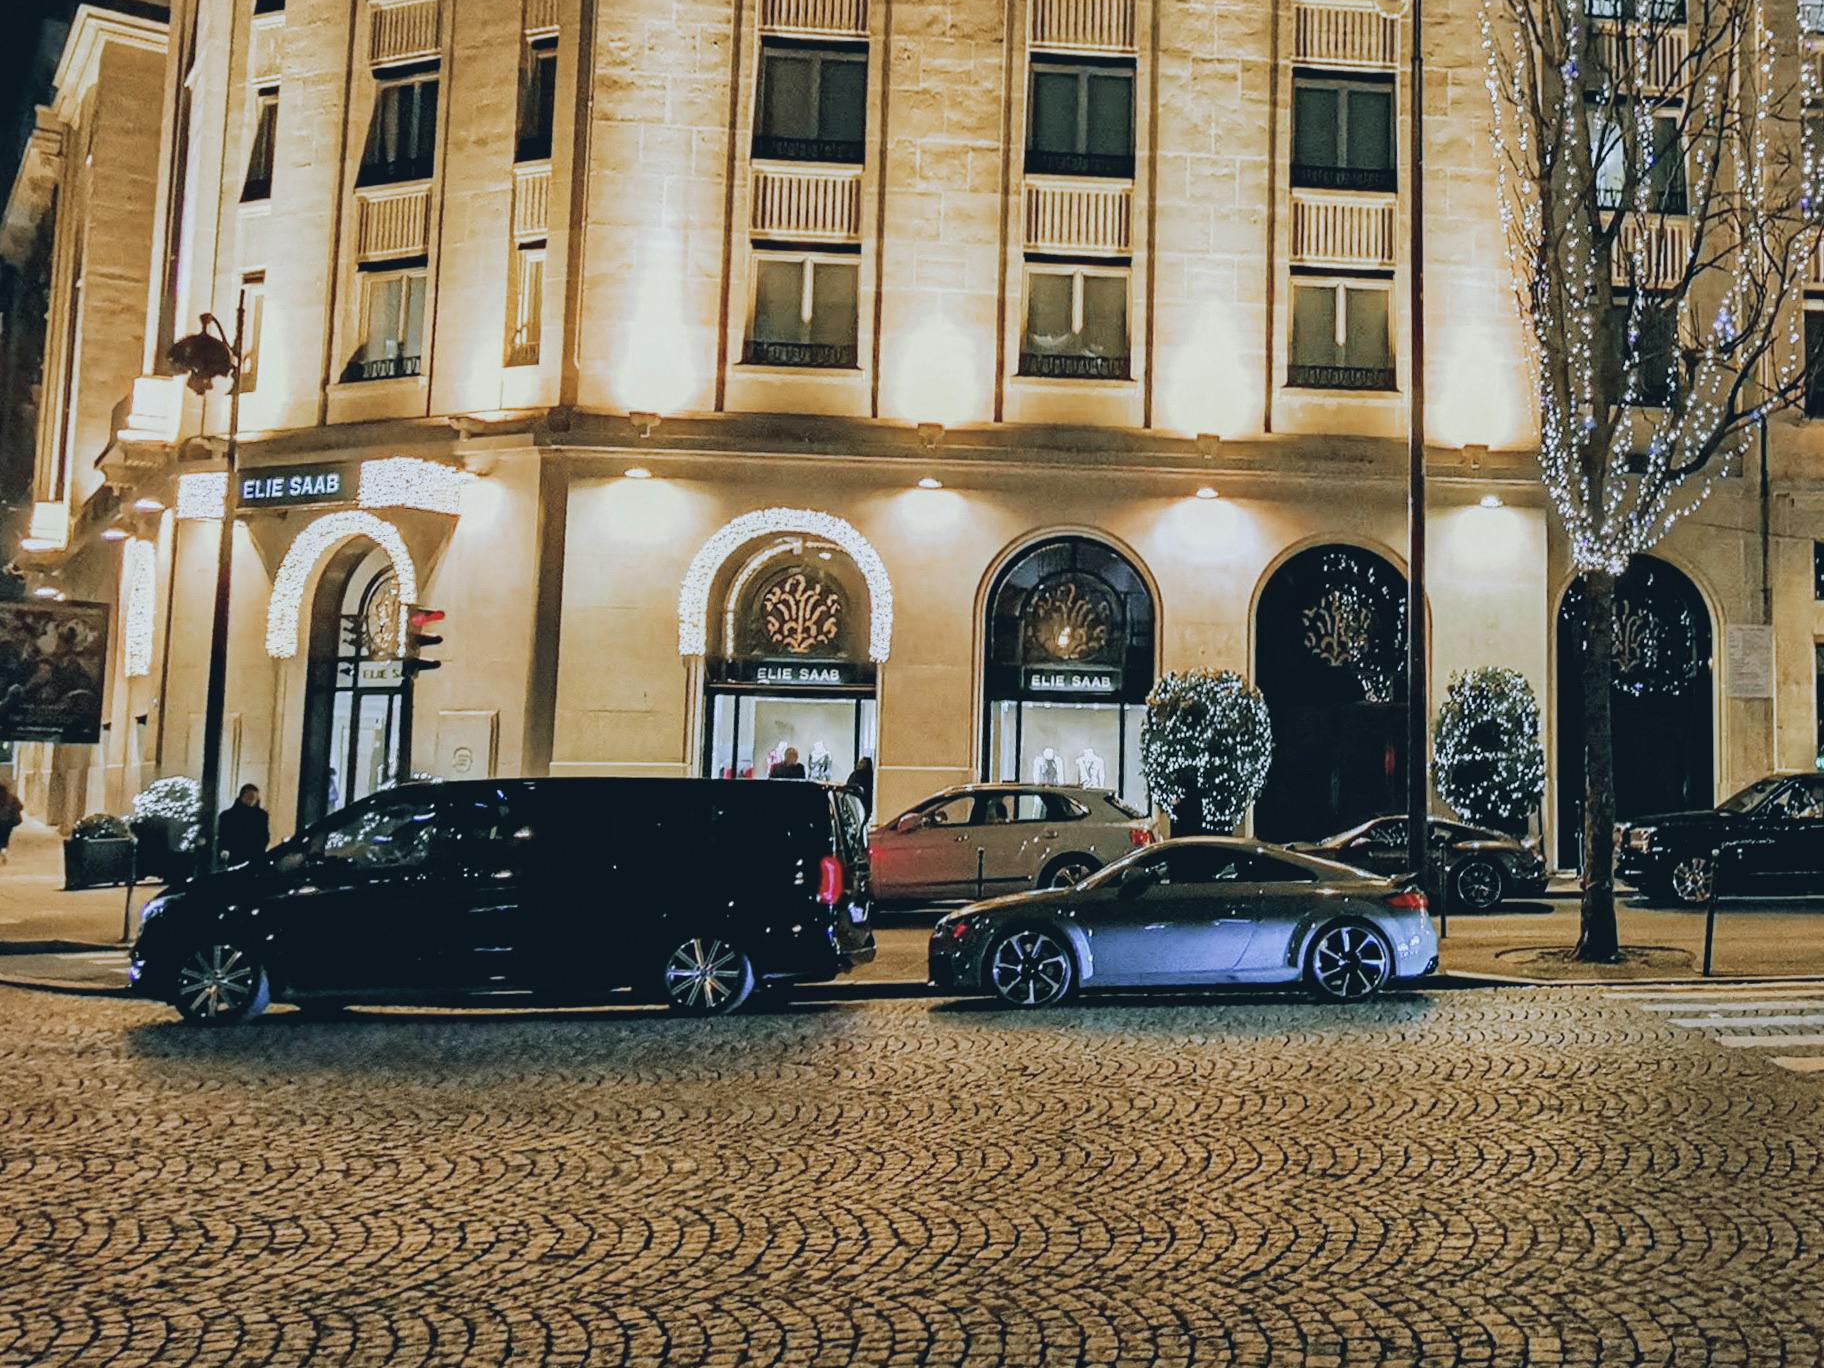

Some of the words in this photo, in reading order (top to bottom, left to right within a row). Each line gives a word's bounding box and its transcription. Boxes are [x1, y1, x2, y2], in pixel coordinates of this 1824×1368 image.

[243, 477, 284, 500] ELIE
[289, 472, 340, 497] SAAB
[757, 667, 793, 681] ELIE
[799, 668, 840, 681] SAAB
[1031, 674, 1065, 688] ELIE
[1071, 675, 1111, 689] SAAB
